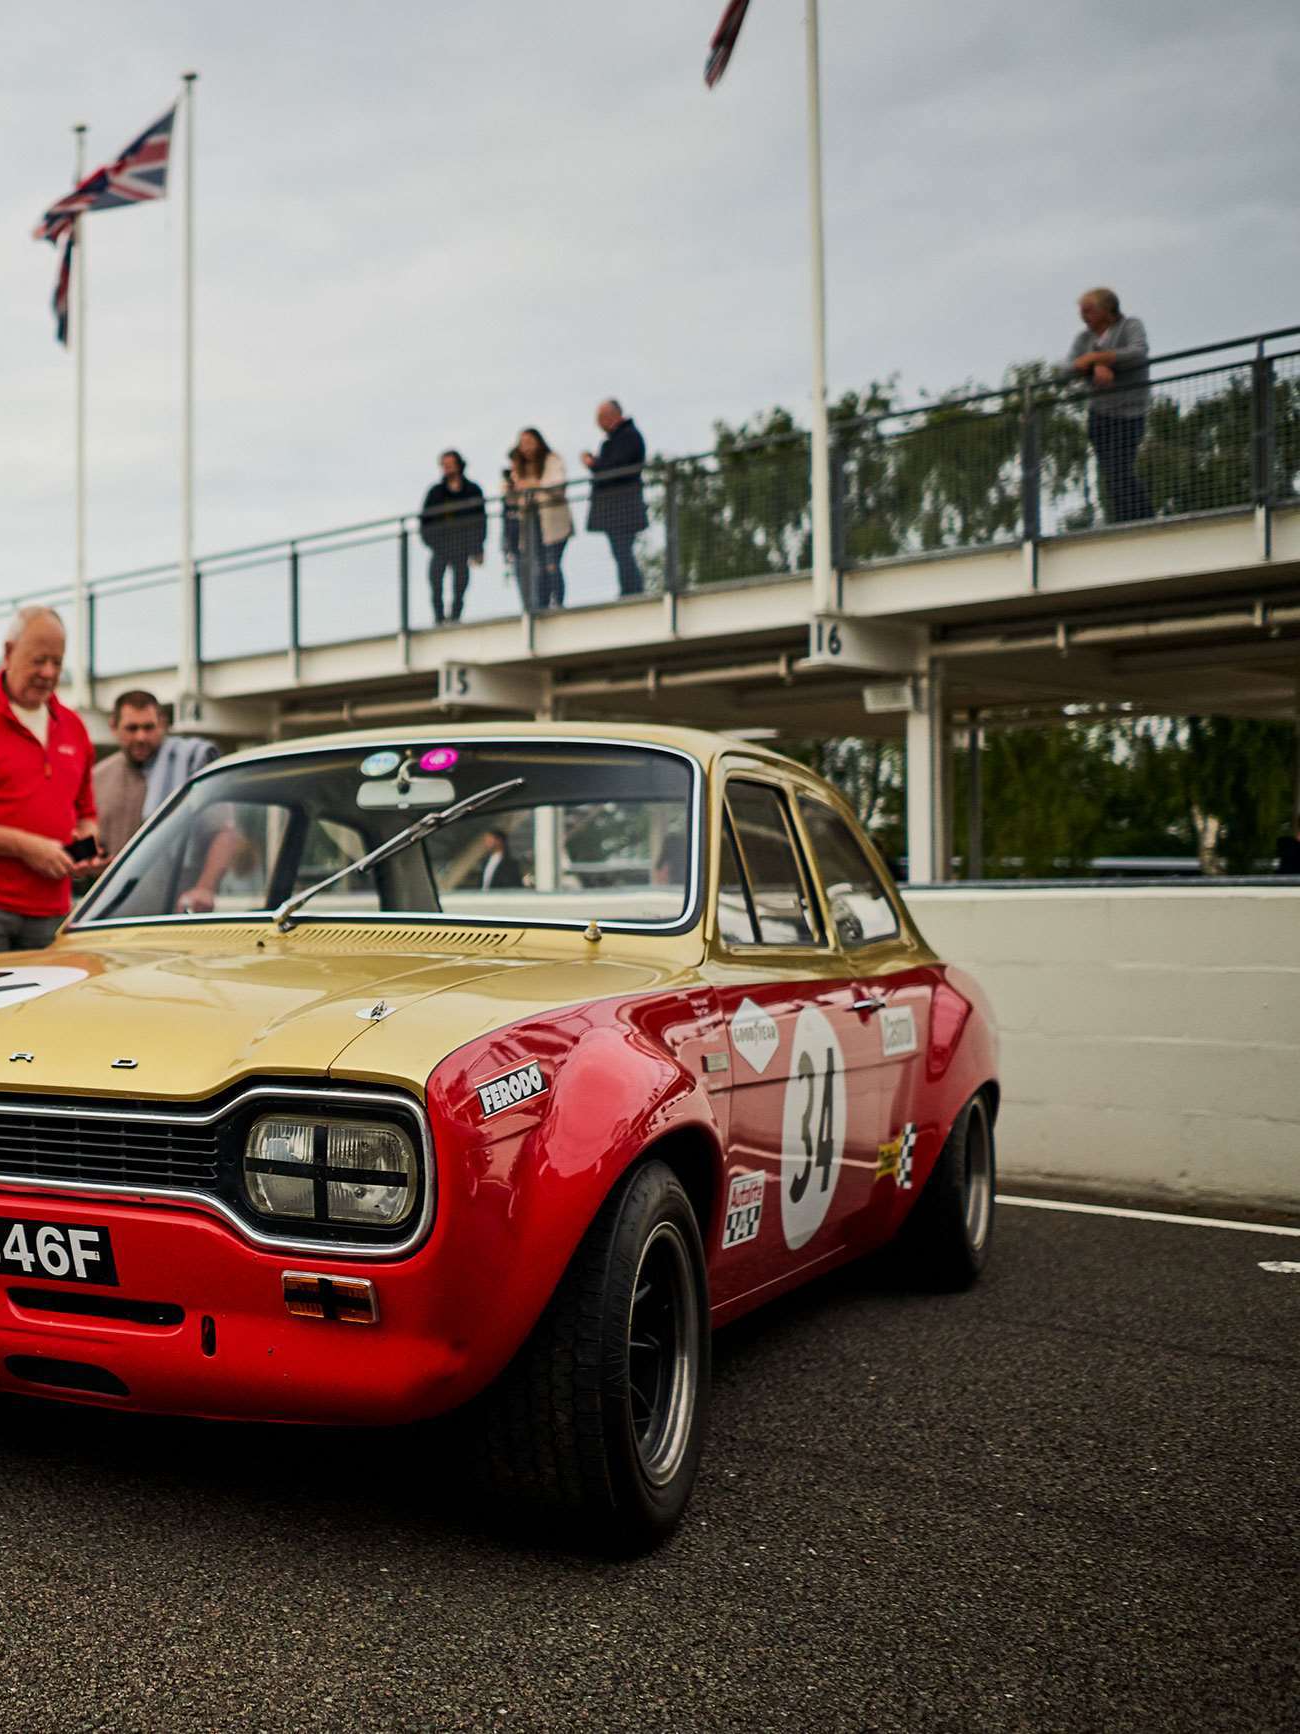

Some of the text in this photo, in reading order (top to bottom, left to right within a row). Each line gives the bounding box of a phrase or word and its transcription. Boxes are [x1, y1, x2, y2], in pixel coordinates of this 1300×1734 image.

[817, 623, 841, 656] 16
[445, 669, 469, 696] 15
[478, 1064, 542, 1115] FERODO
[789, 1047, 836, 1204] 34
